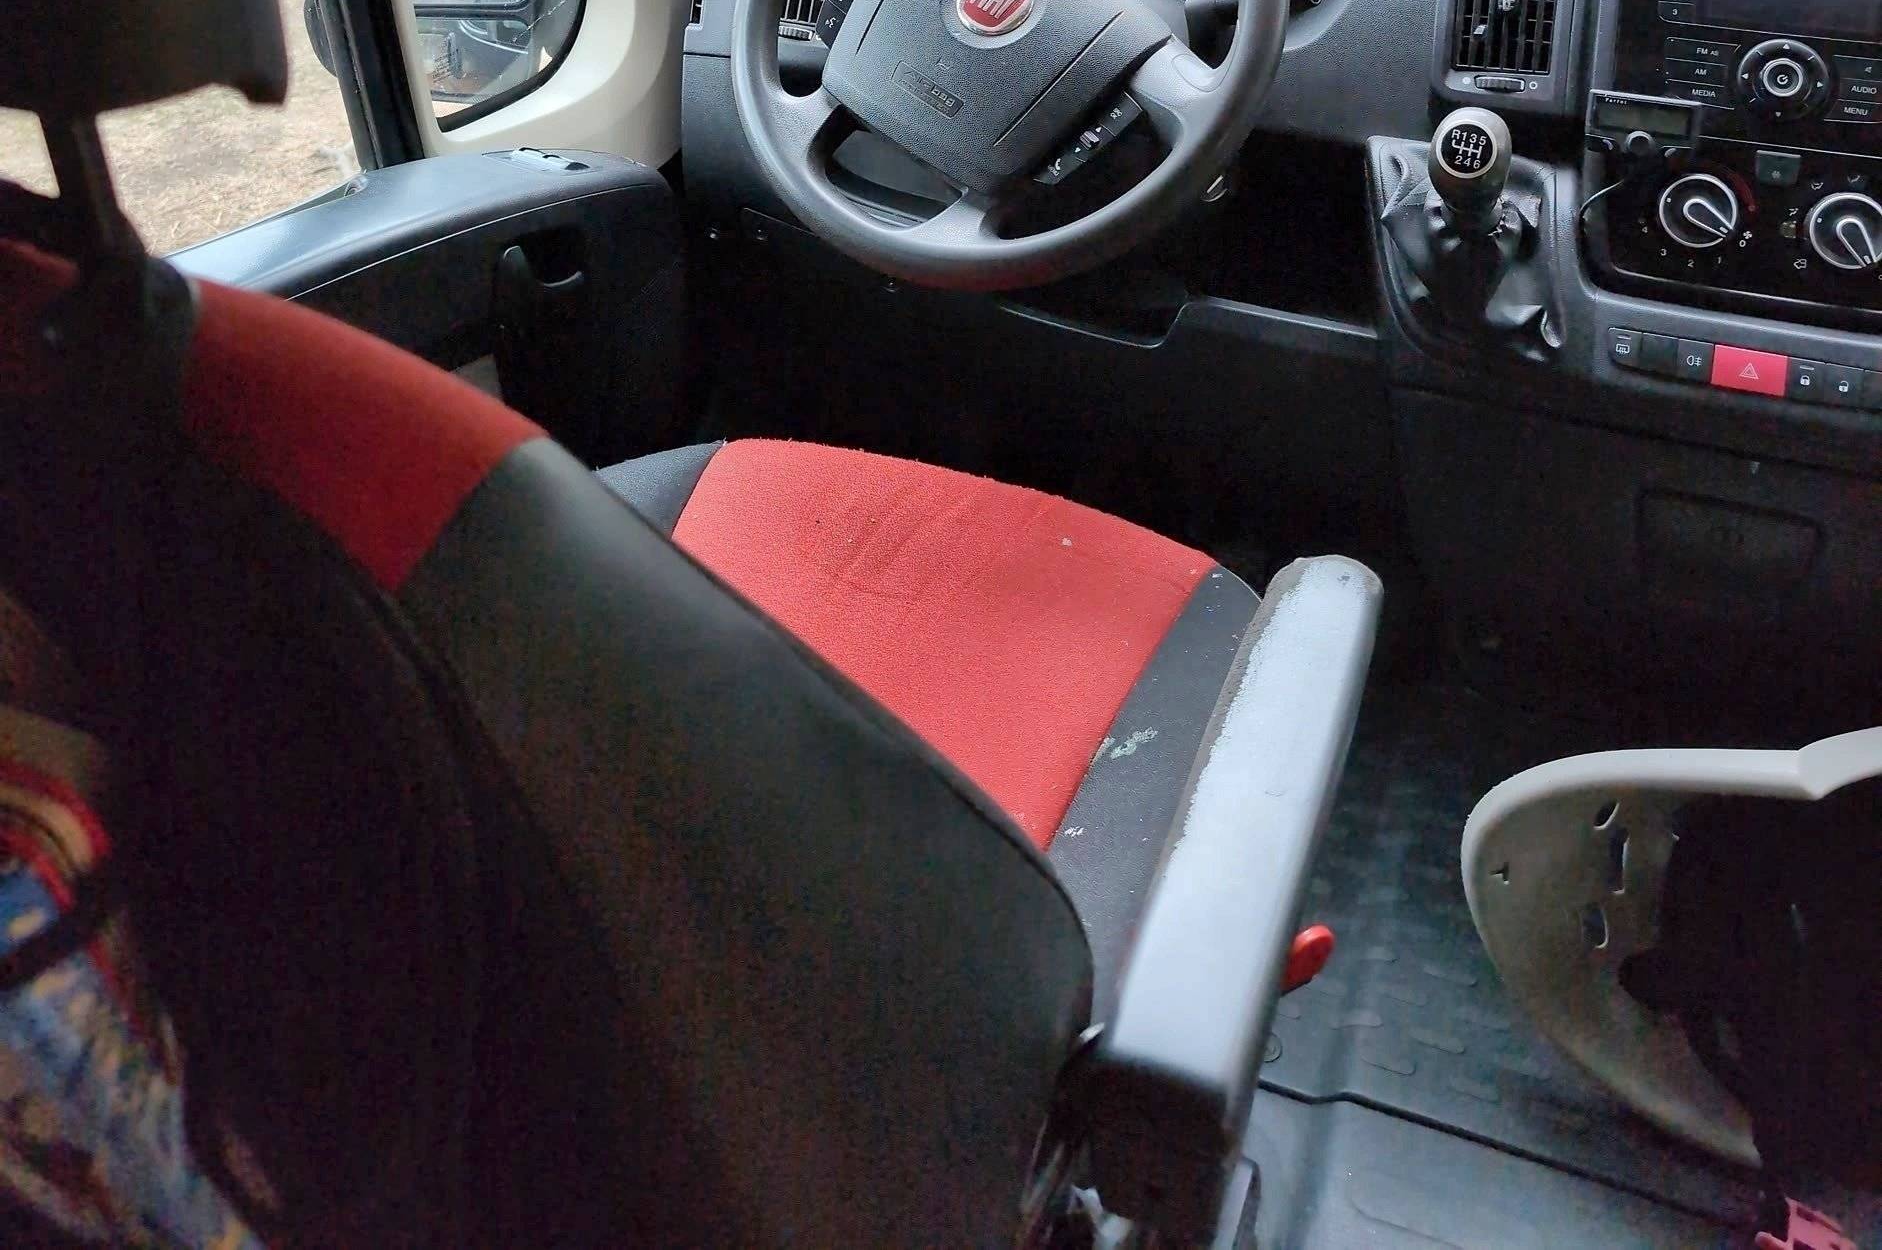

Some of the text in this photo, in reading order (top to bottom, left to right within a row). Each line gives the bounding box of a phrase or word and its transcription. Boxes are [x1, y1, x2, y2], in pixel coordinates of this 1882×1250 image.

[1696, 47, 1708, 55] FM
[1694, 68, 1707, 76] AM
[1691, 88, 1716, 98] MEDIA
[1851, 85, 1878, 95] AUDIO
[1843, 106, 1868, 116] MENU
[1660, 248, 1668, 256] 3
[1687, 259, 1694, 268] 2
